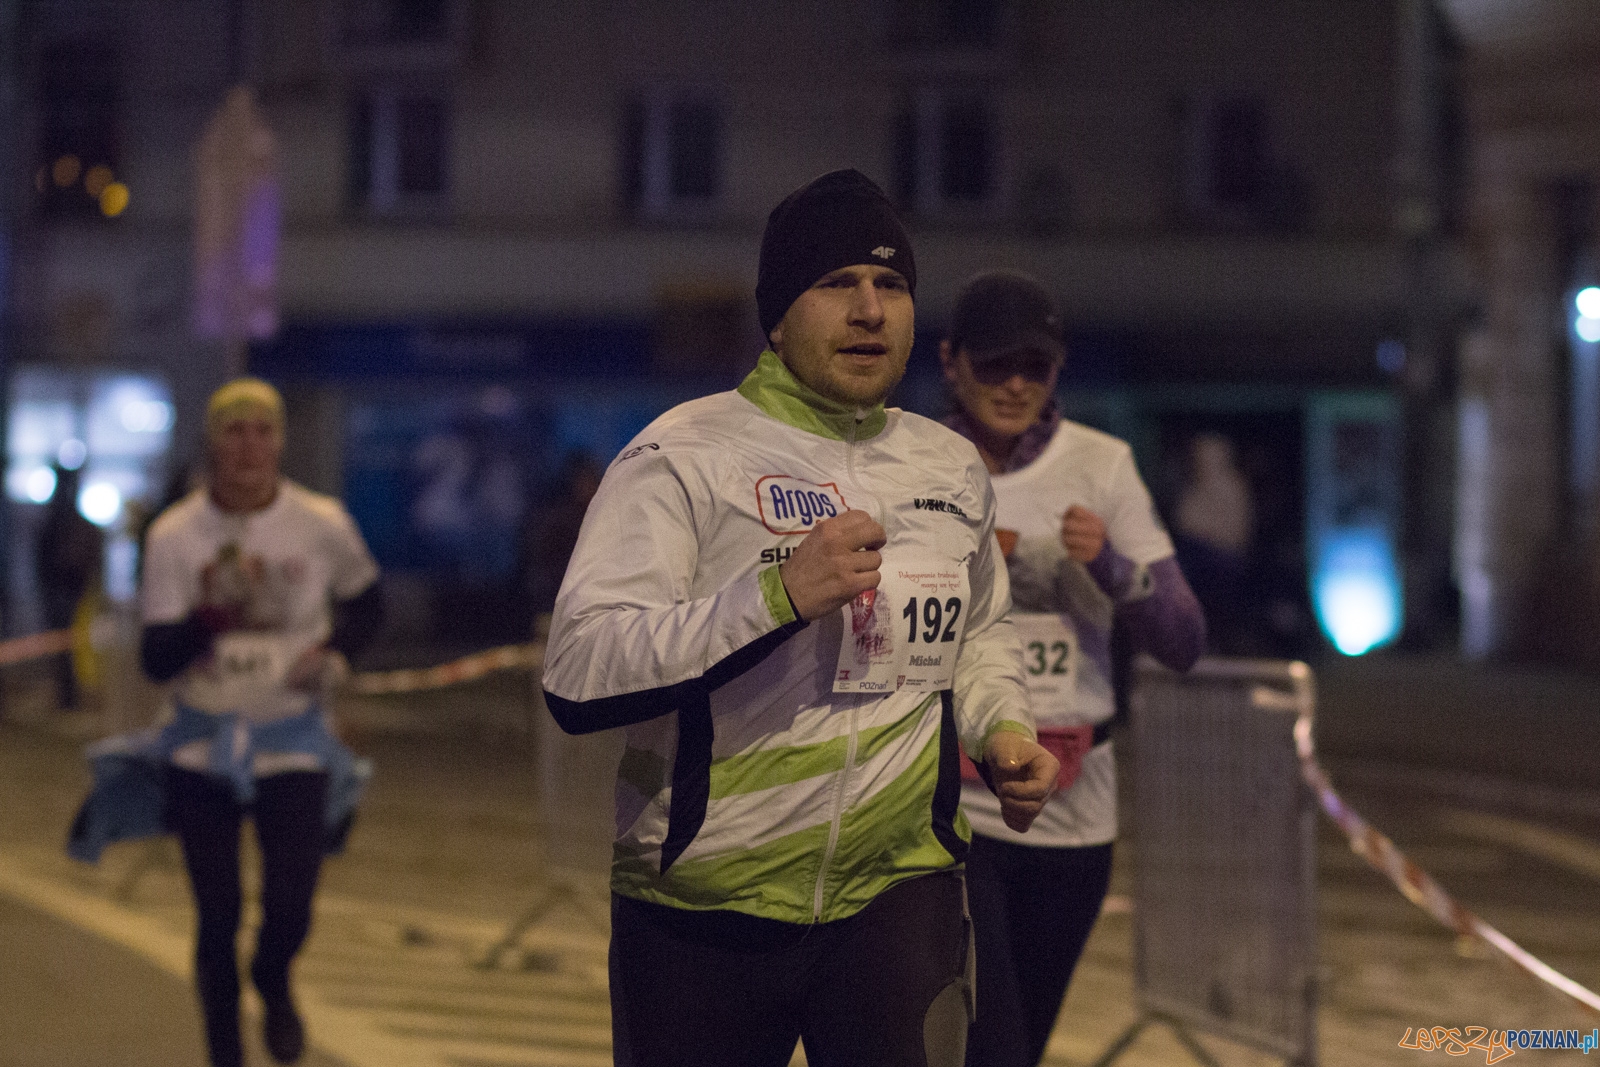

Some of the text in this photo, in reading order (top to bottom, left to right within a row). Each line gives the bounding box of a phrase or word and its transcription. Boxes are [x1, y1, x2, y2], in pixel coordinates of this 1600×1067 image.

[871, 246, 896, 259] 4F
[769, 484, 837, 526] Argos
[903, 597, 962, 643] 192
